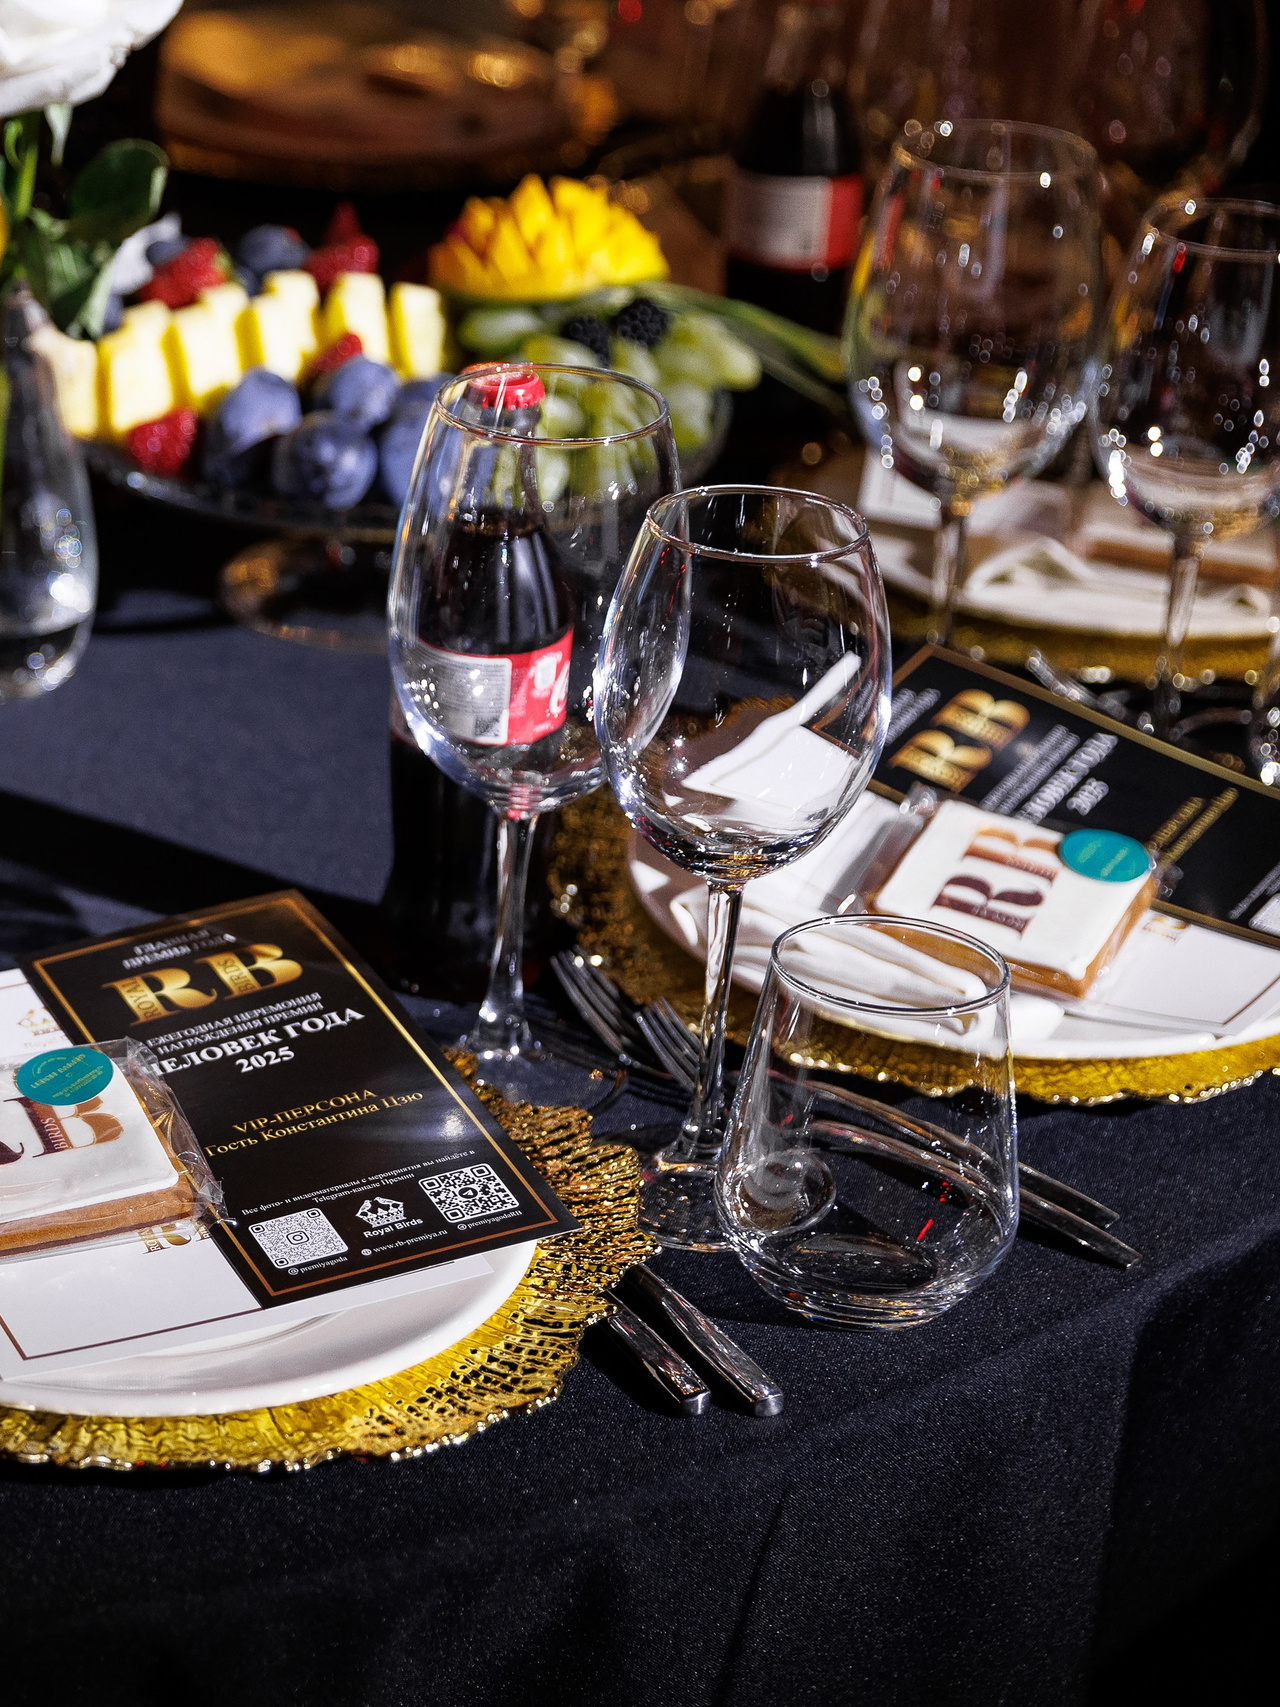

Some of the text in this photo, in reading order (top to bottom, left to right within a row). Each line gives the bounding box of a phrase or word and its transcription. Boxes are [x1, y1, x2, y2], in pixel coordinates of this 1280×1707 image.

[122, 945, 191, 970] ПРЕМИЯ
[222, 956, 257, 993] BIRDS
[102, 943, 303, 1027] RB
[122, 977, 161, 1019] ROYAL
[147, 991, 322, 1048] ЕЖЕГОДНАЯ ЦЕРЕМОНИЯ
[157, 1001, 324, 1055] НАГРАЖДЕНИЯ ПРЕМИИ
[142, 1007, 365, 1076] ЧЕЛОВЕК ГОДА
[235, 1046, 295, 1073] 2025
[204, 1091, 424, 1157] Гость Константина Цзю
[232, 1088, 378, 1134] VIP-ПЕРСОНА
[40, 1117, 68, 1150] BIRDS
[241, 1207, 258, 1216] Все
[259, 1198, 283, 1211] фото-
[293, 1180, 360, 1203] видеоматериалы
[368, 1163, 422, 1182] мероприятия
[312, 1172, 415, 1204] Telegram-канале Премии
[363, 1217, 423, 1238] Royal Birds
[467, 1210, 523, 1229] premiyagodaRB
[373, 1228, 448, 1253] www.rb-premiya.ru
[299, 1255, 348, 1274] premiyagoda
